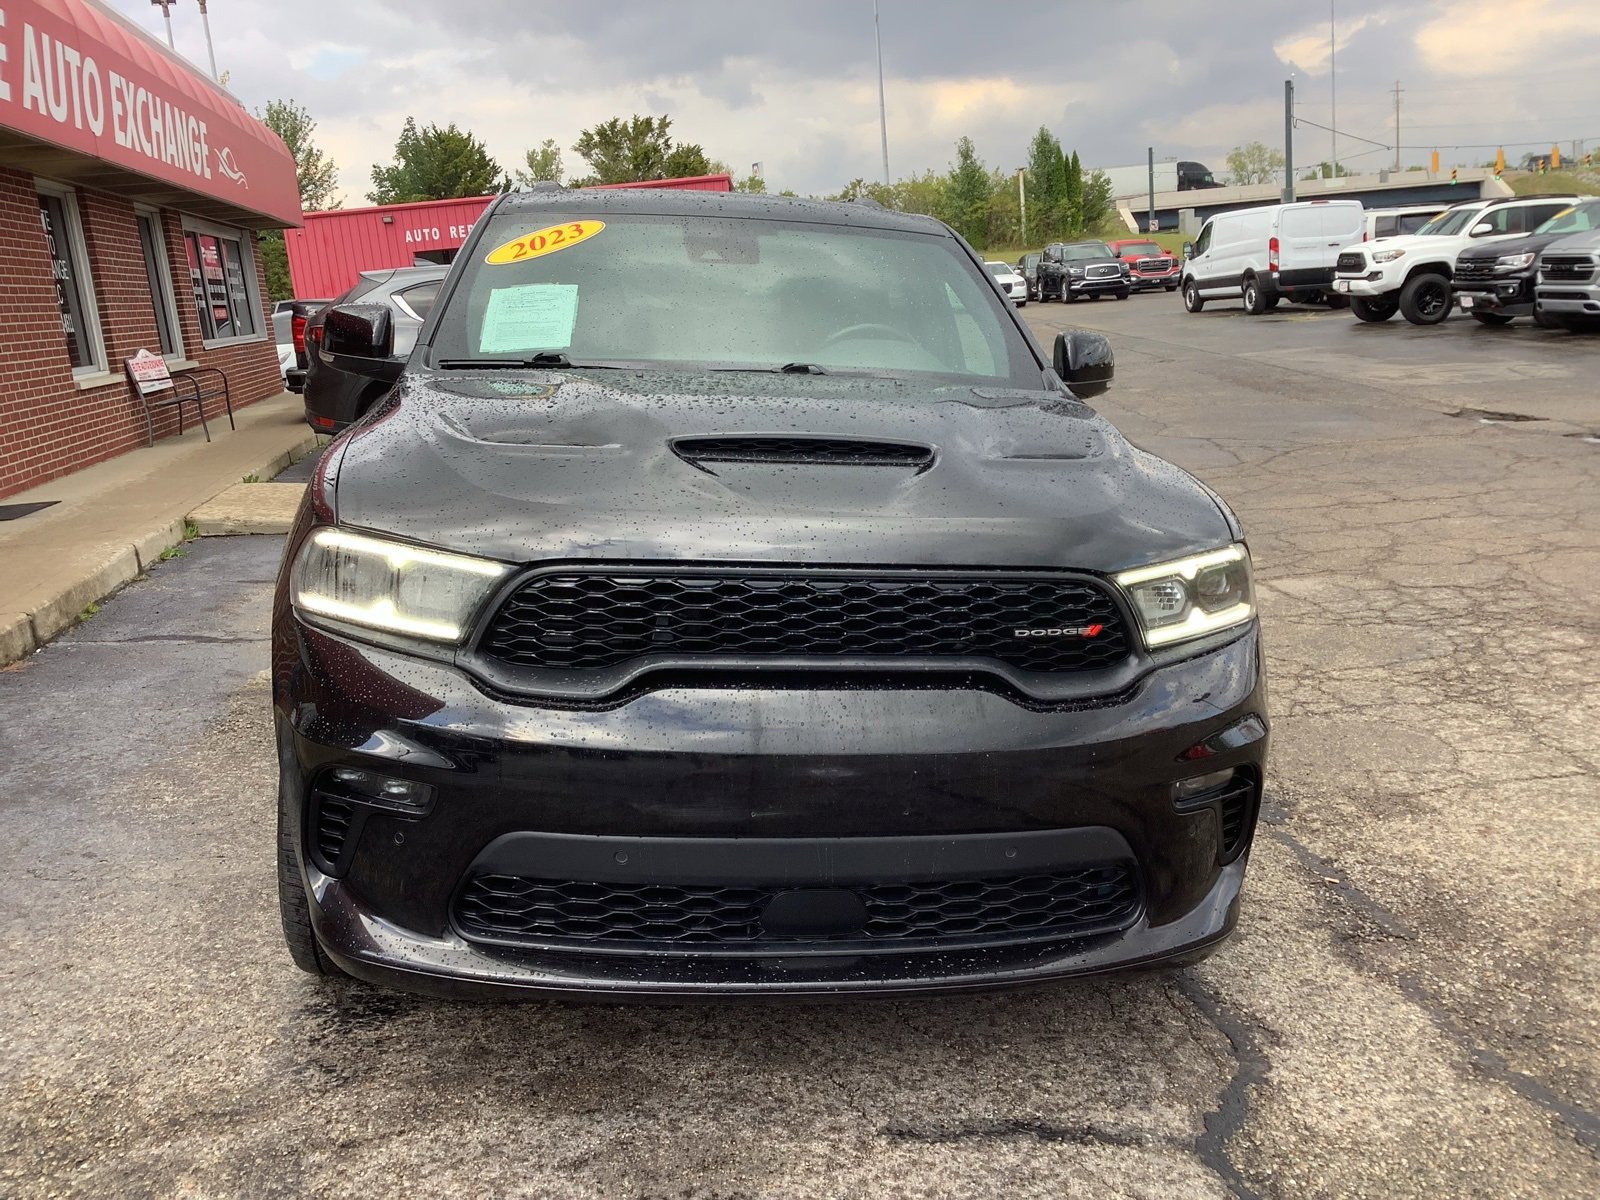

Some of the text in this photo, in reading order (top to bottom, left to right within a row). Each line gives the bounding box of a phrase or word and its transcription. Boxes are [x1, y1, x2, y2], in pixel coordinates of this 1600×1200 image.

[23, 22, 104, 137] AUTO
[109, 70, 212, 180] EXCHANGE
[406, 227, 440, 243] AUTO
[510, 223, 584, 260] 2023
[1015, 627, 1091, 637] DODGE
